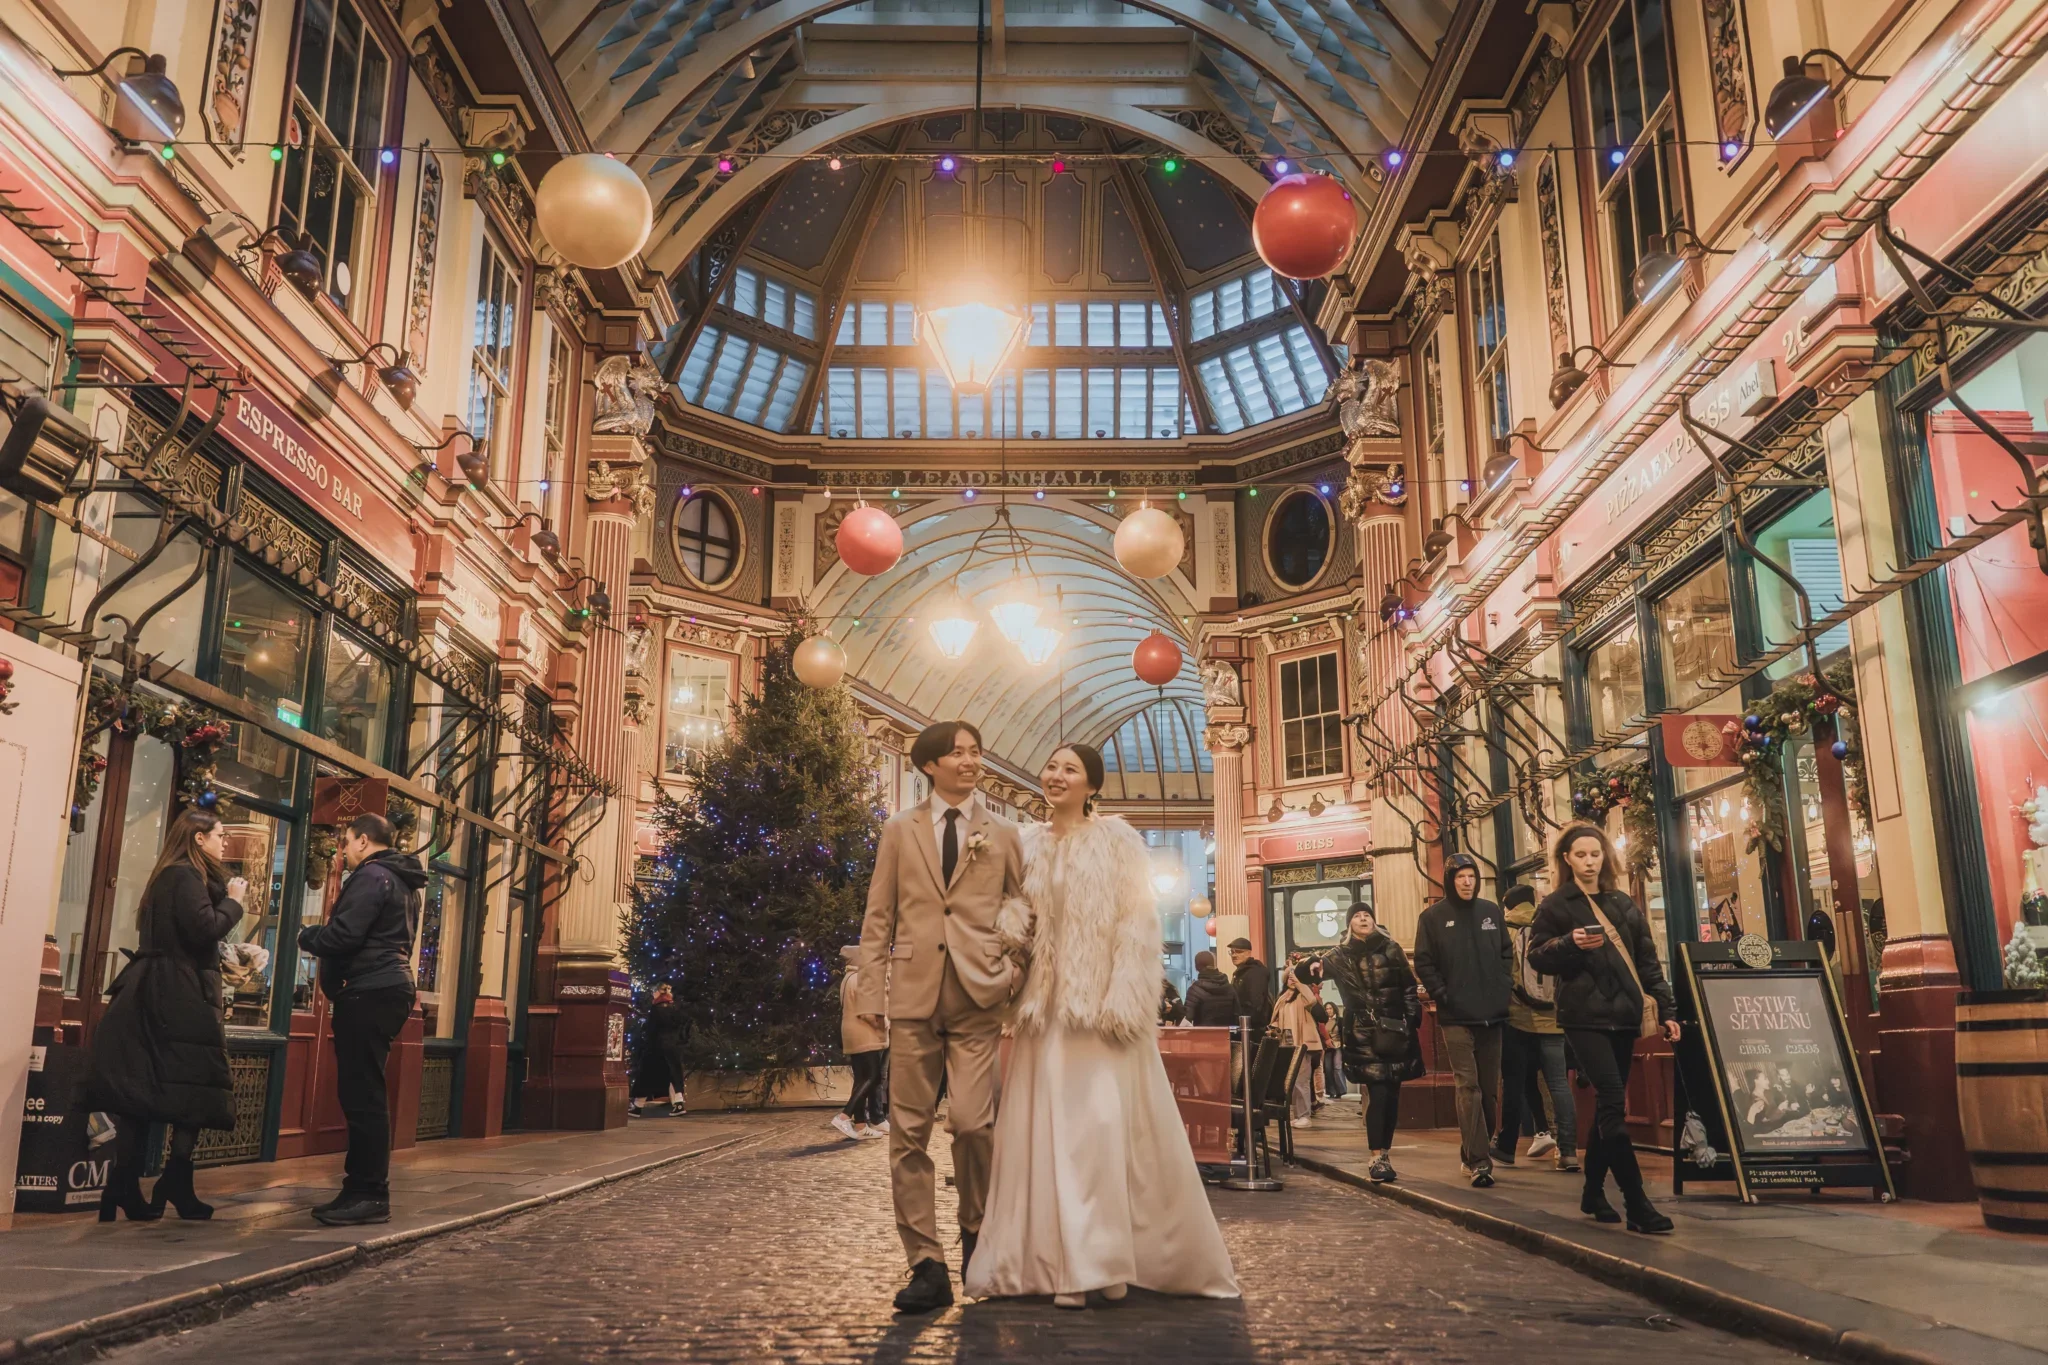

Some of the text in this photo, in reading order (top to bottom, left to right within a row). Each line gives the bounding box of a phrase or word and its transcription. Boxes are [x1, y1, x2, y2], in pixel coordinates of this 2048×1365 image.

[1739, 376, 1761, 404] Abel
[236, 394, 363, 521] ESPRESSO BAR
[902, 470, 1112, 486] LEADENHALL
[1296, 838, 1335, 851] REISS
[1733, 995, 1800, 1013] FESTIVE
[1729, 1012, 1812, 1030] SET MENU
[1739, 1045, 1771, 1055] £19.95
[26, 1098, 45, 1110] ee
[44, 1115, 64, 1124] copy
[18, 1160, 111, 1189] ATTERS CM
